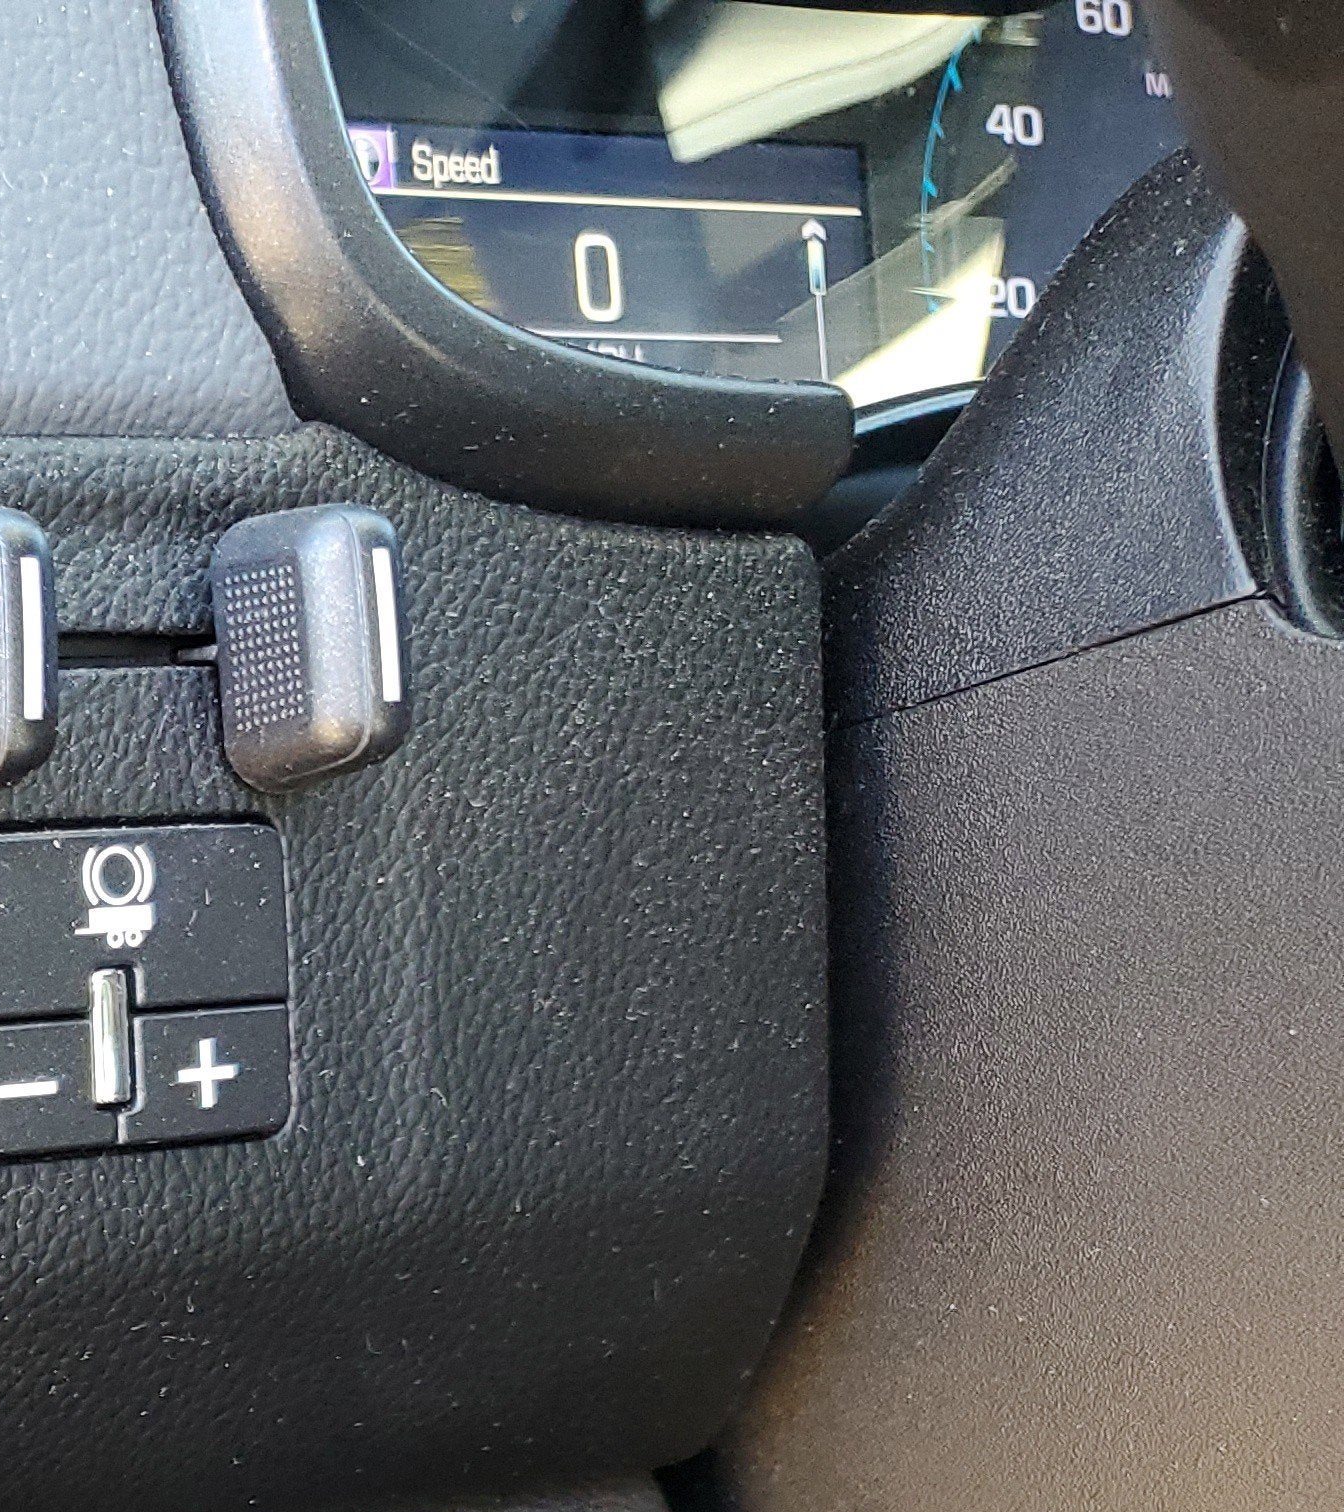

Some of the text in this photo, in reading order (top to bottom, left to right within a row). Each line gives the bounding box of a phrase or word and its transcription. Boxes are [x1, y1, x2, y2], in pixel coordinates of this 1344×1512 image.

[985, 104, 1044, 146] 40
[411, 138, 502, 188] Speed
[574, 231, 622, 322] 0
